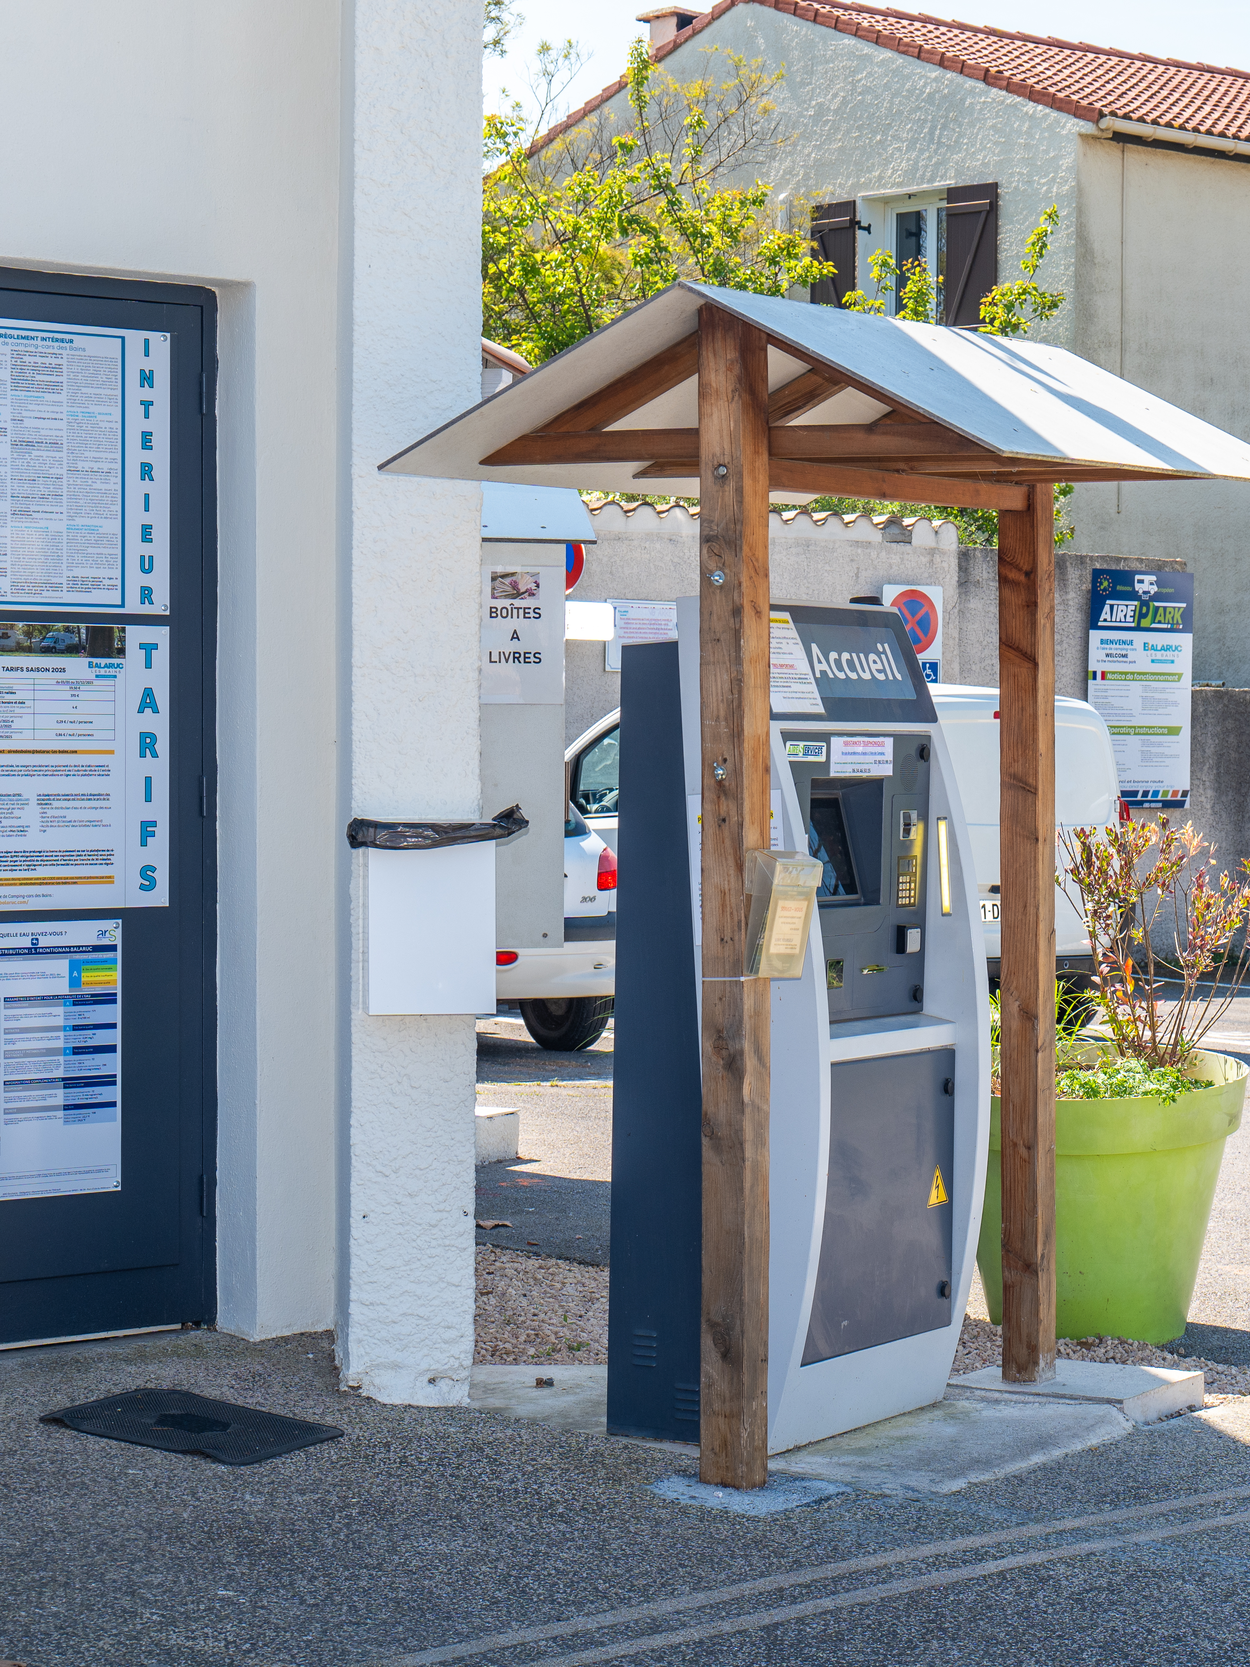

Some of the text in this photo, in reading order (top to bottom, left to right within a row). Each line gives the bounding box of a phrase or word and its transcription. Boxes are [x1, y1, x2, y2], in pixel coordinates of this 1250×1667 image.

[0, 333, 74, 344] RÈGLEMENT INTÉRIEUR
[11, 341, 55, 350] camping-cars
[139, 338, 155, 605] INTERIEUR
[489, 603, 542, 619] BOÎTES
[510, 629, 520, 641] A
[1100, 638, 1134, 646] BIENVENUE
[1143, 642, 1183, 652] BALARUC
[489, 651, 542, 664] LIVRES
[810, 642, 902, 681] Accueil
[88, 661, 124, 669] BALARUC
[1133, 673, 1179, 681] fonctionnement
[1135, 726, 1168, 734] instructions
[137, 643, 160, 892] TARIFS
[580, 895, 597, 904] 206
[97, 929, 117, 942] ars
